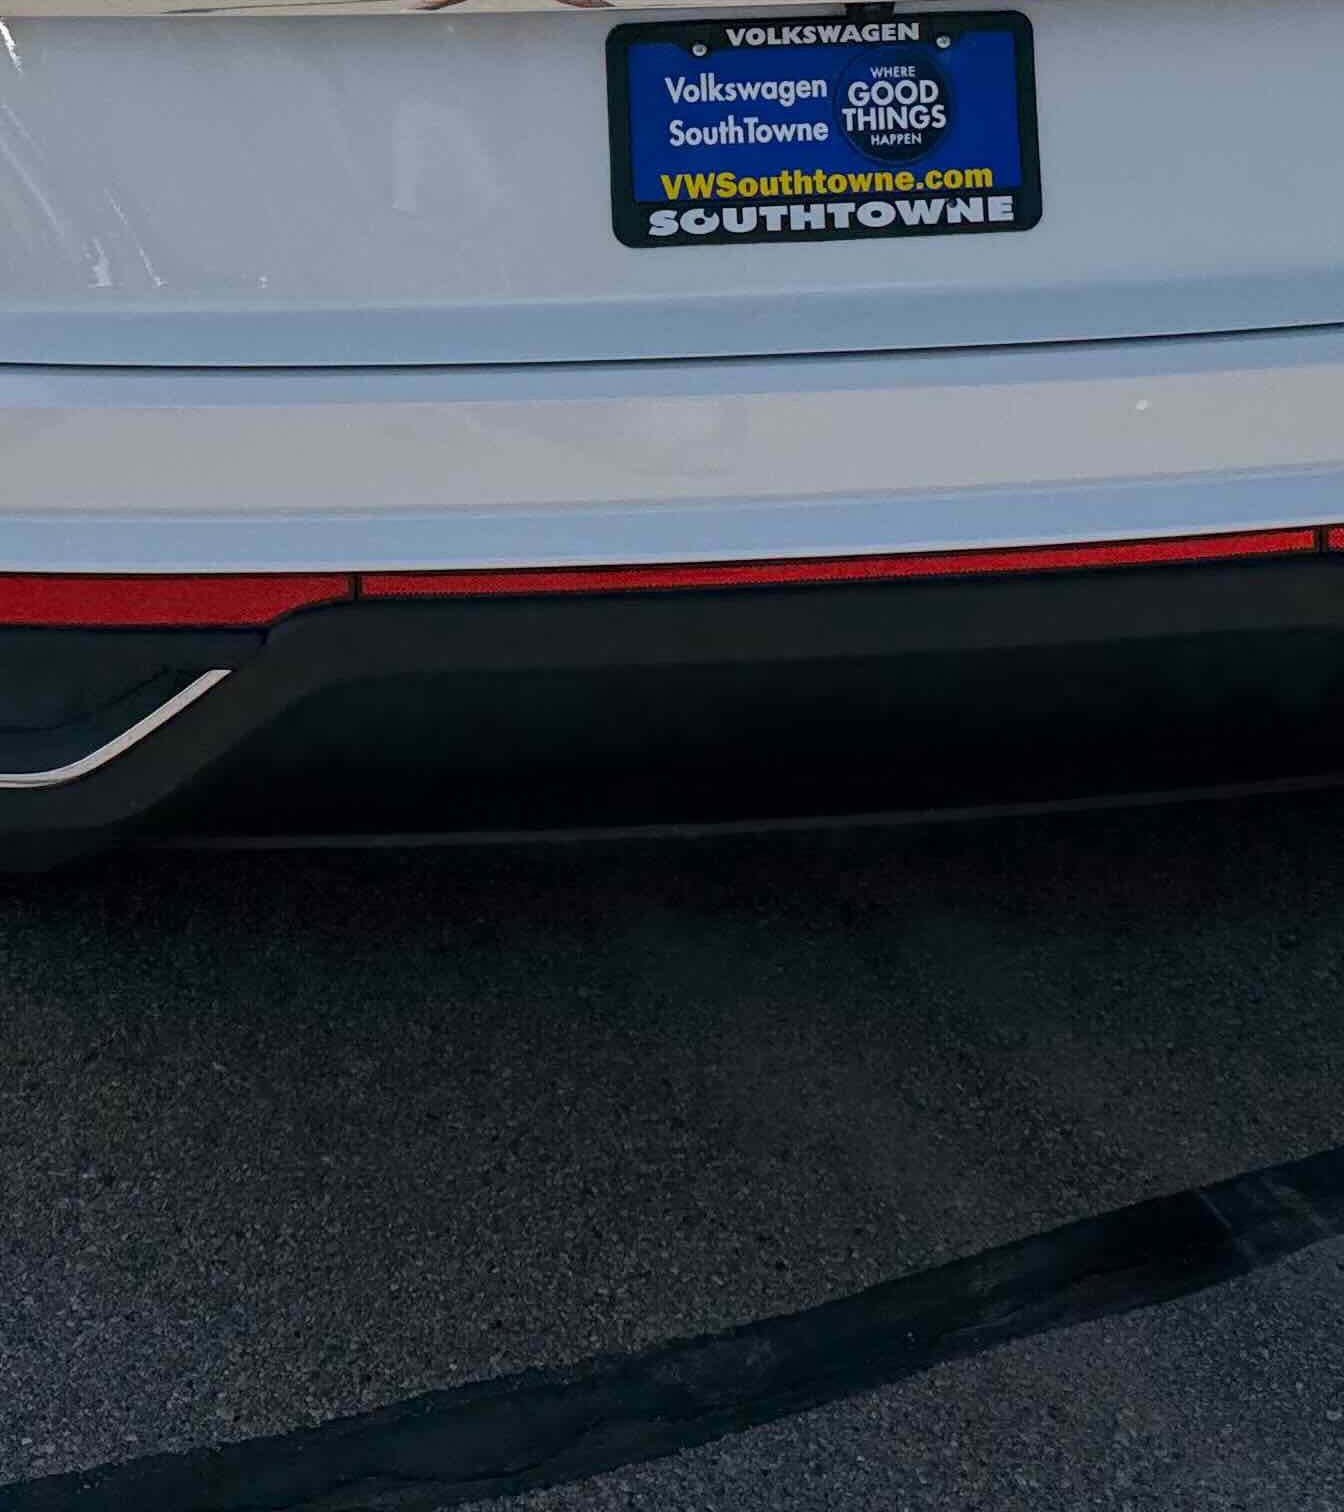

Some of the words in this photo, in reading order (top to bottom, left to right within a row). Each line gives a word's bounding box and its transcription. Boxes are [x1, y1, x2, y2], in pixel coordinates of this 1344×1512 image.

[726, 22, 920, 46] VOLKSWAGEN
[871, 66, 916, 78] WHERE
[665, 73, 827, 106] Volkswagen
[848, 80, 939, 106] GOOD
[669, 115, 829, 146] SouthTowne
[842, 104, 946, 132] THINGS
[871, 133, 922, 145] HAPPEN
[660, 168, 992, 200] VWSouthtowne.com
[648, 196, 1014, 236] SOUTHTOWNE
